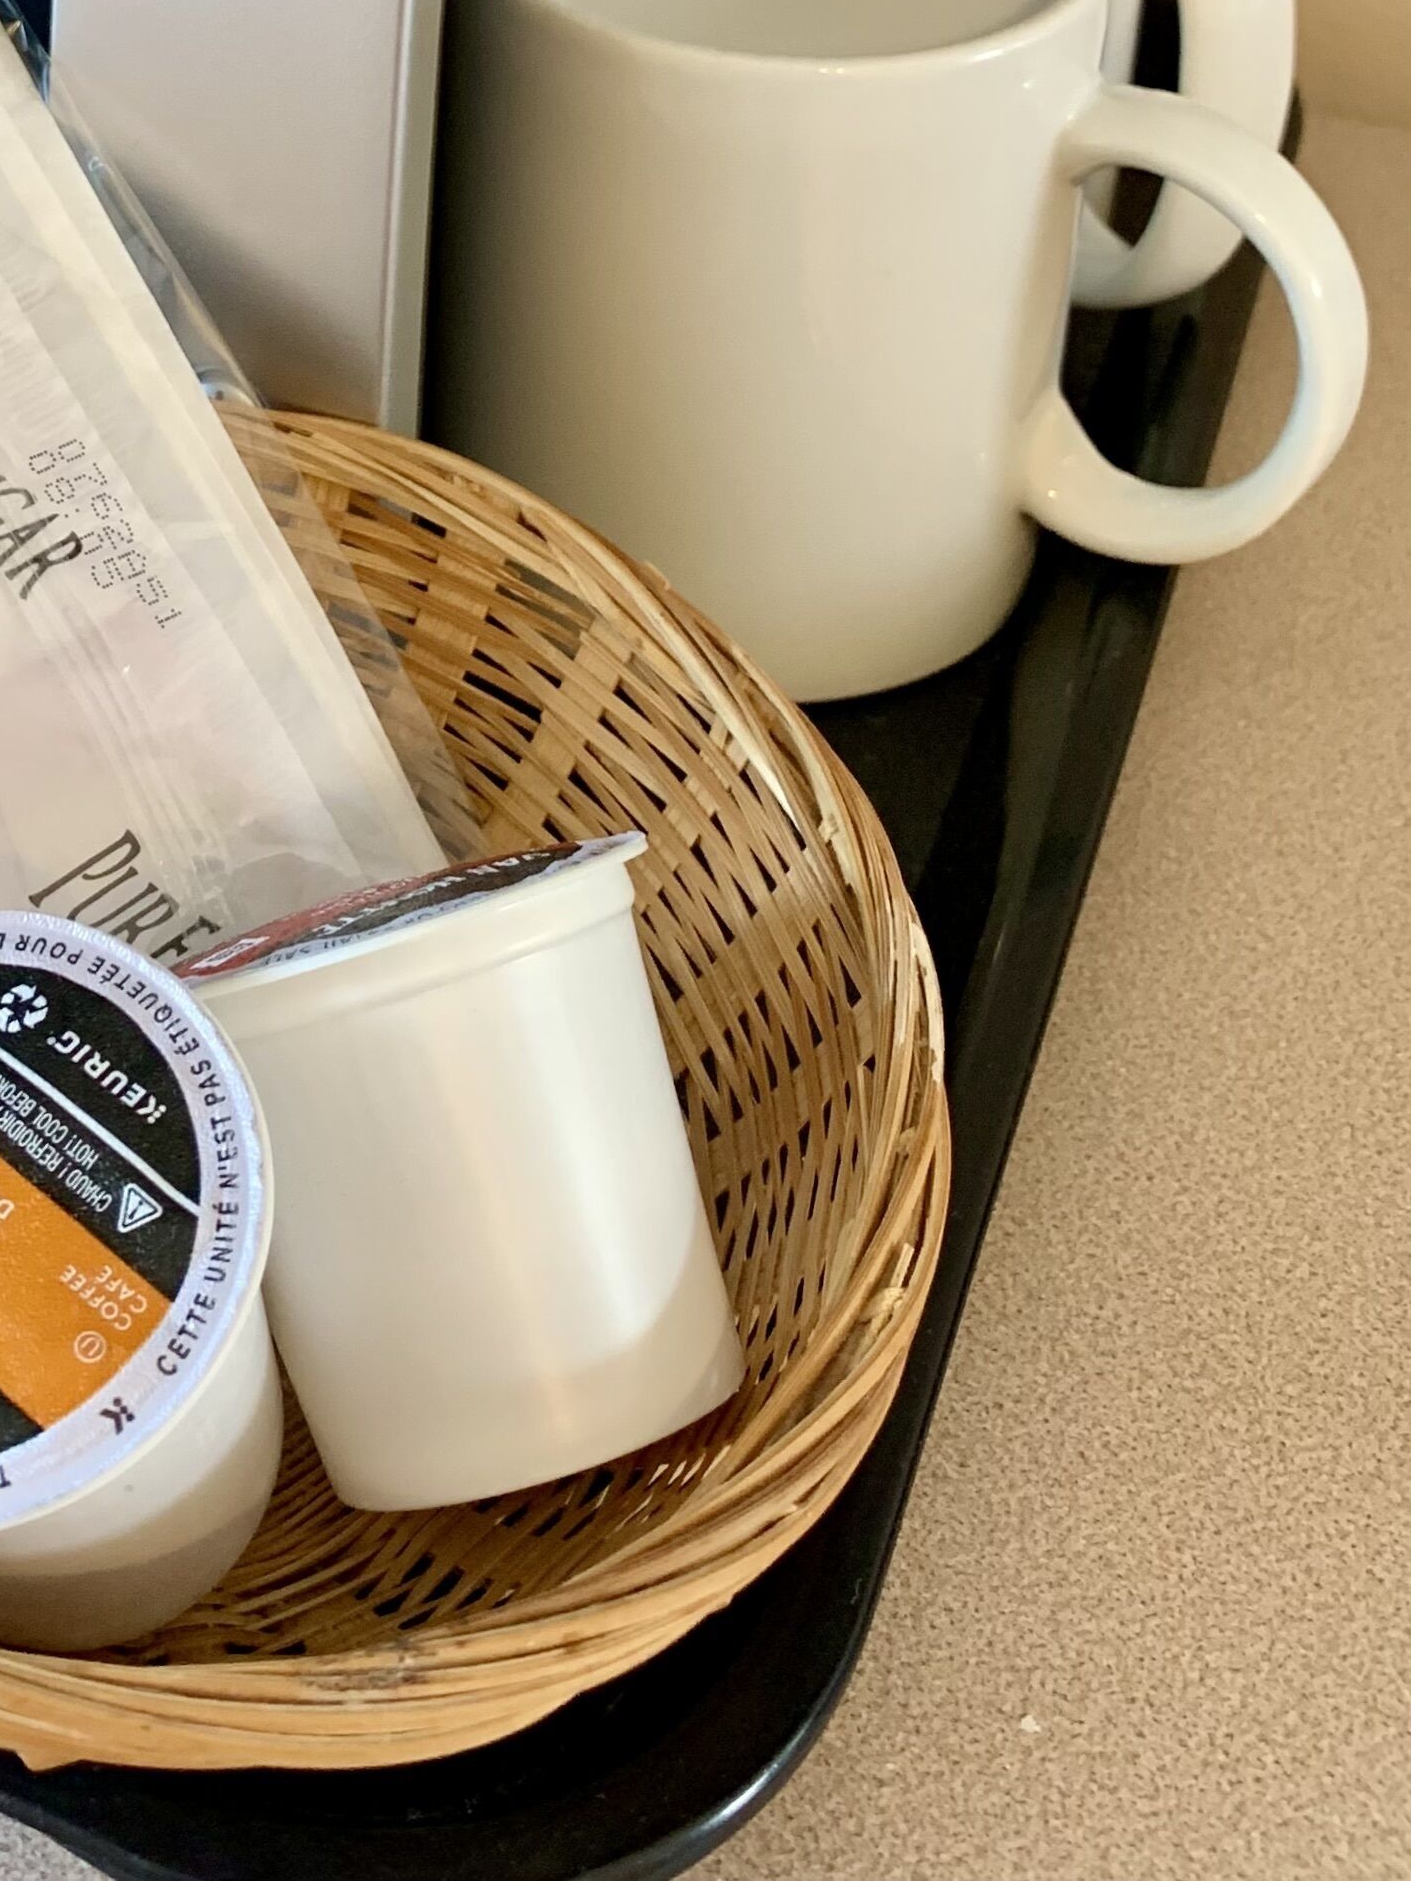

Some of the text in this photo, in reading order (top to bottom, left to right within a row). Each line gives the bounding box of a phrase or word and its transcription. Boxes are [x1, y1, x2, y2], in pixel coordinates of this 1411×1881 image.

[29, 829, 221, 959] PURE
[14, 932, 85, 965] POUR
[87, 957, 200, 1057] ÉTIQUETÉE
[55, 1029, 167, 1123] KEURIG
[190, 1057, 231, 1106] PAS
[32, 1106, 70, 1145] COOL
[62, 1134, 101, 1170] HOT!
[210, 1110, 238, 1188] N'EST
[65, 1168, 113, 1213] CHAUD
[207, 1199, 240, 1282] UNITÉ
[58, 1263, 134, 1332] COFFEE
[101, 1264, 148, 1315] CAFÉ
[156, 1291, 216, 1377] CETTE
